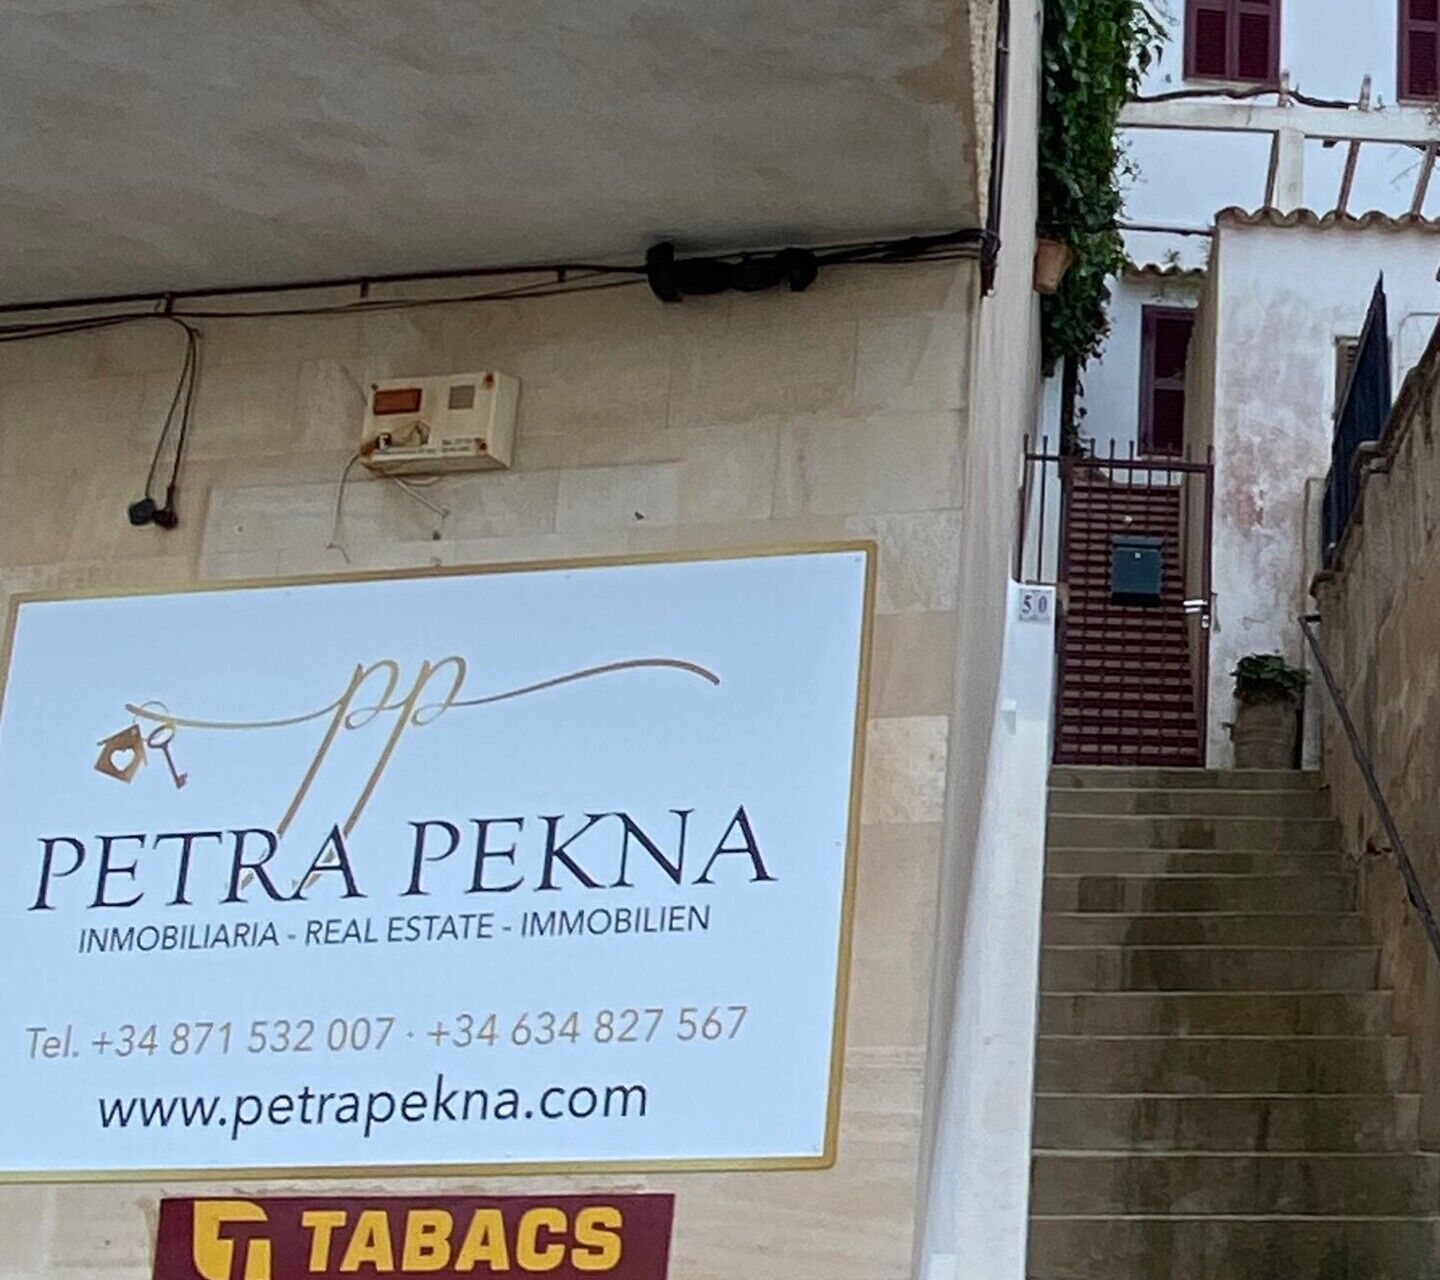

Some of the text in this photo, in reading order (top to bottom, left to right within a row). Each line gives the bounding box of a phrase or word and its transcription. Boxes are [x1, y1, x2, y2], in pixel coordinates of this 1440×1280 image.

[28, 803, 779, 911] PETRA PEKNA
[78, 921, 280, 954] INMOBILIARIA
[304, 918, 379, 947] REAL
[387, 912, 495, 943] ESTATE
[520, 904, 711, 938] IMMOBILIEN
[25, 1024, 80, 1059] Tel.
[91, 1023, 159, 1058] +34
[169, 1021, 233, 1055] 871
[247, 1019, 315, 1054] 532
[326, 1017, 397, 1052] 007
[427, 1013, 499, 1048] +34
[511, 1011, 581, 1047] 634
[593, 1007, 665, 1044] 827
[675, 1005, 748, 1041] 567
[97, 1073, 648, 1140] www.petrapekna.com
[301, 1206, 624, 1272] TABACS
